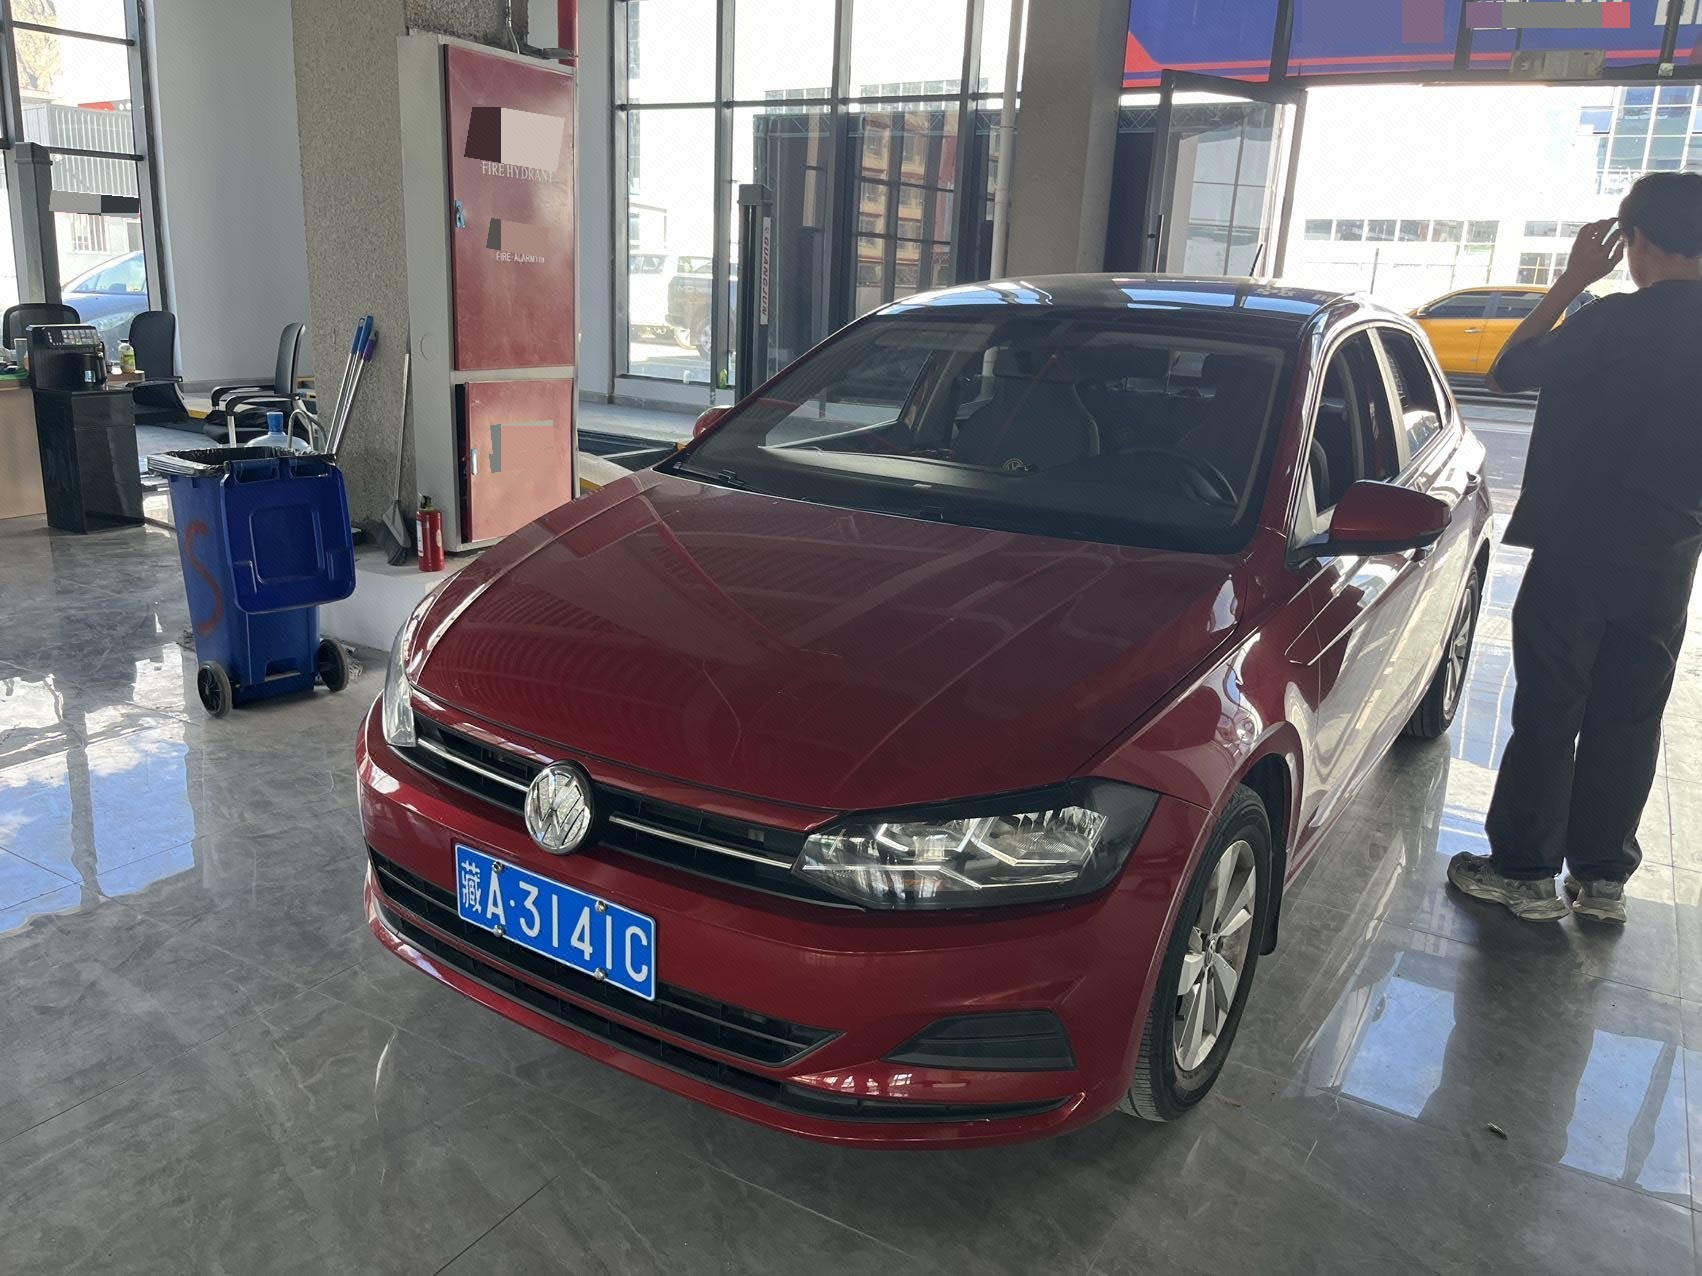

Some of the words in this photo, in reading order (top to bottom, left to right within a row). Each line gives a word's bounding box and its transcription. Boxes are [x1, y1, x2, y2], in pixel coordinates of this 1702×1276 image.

[482, 161, 504, 177] FIRE
[506, 164, 552, 183] HYDRANT
[496, 251, 511, 262] FIRE
[761, 236, 770, 316] GUANGJUN
[184, 520, 224, 635] S
